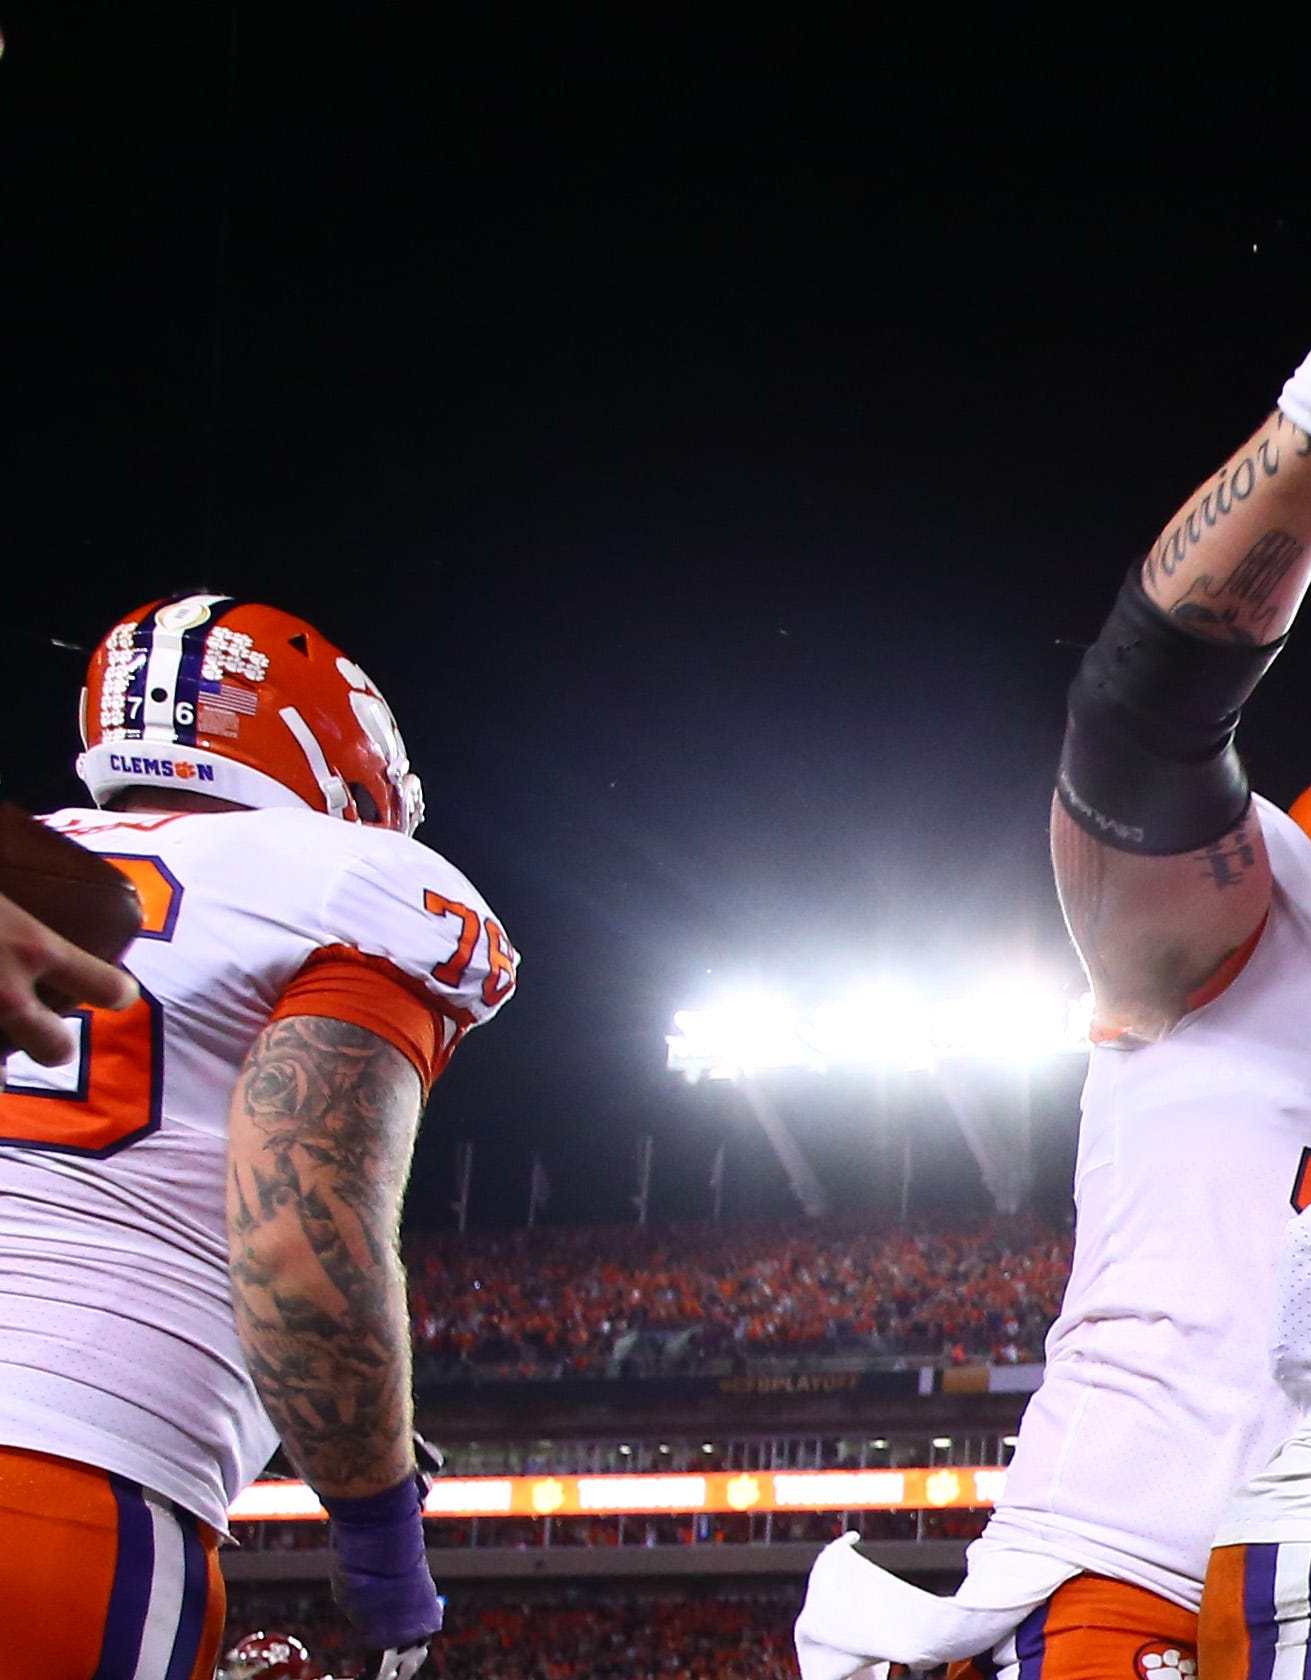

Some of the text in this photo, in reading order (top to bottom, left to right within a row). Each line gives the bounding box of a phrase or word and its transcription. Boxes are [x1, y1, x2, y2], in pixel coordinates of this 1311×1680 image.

[127, 697, 194, 725] 7 6
[424, 888, 516, 1007] 76
